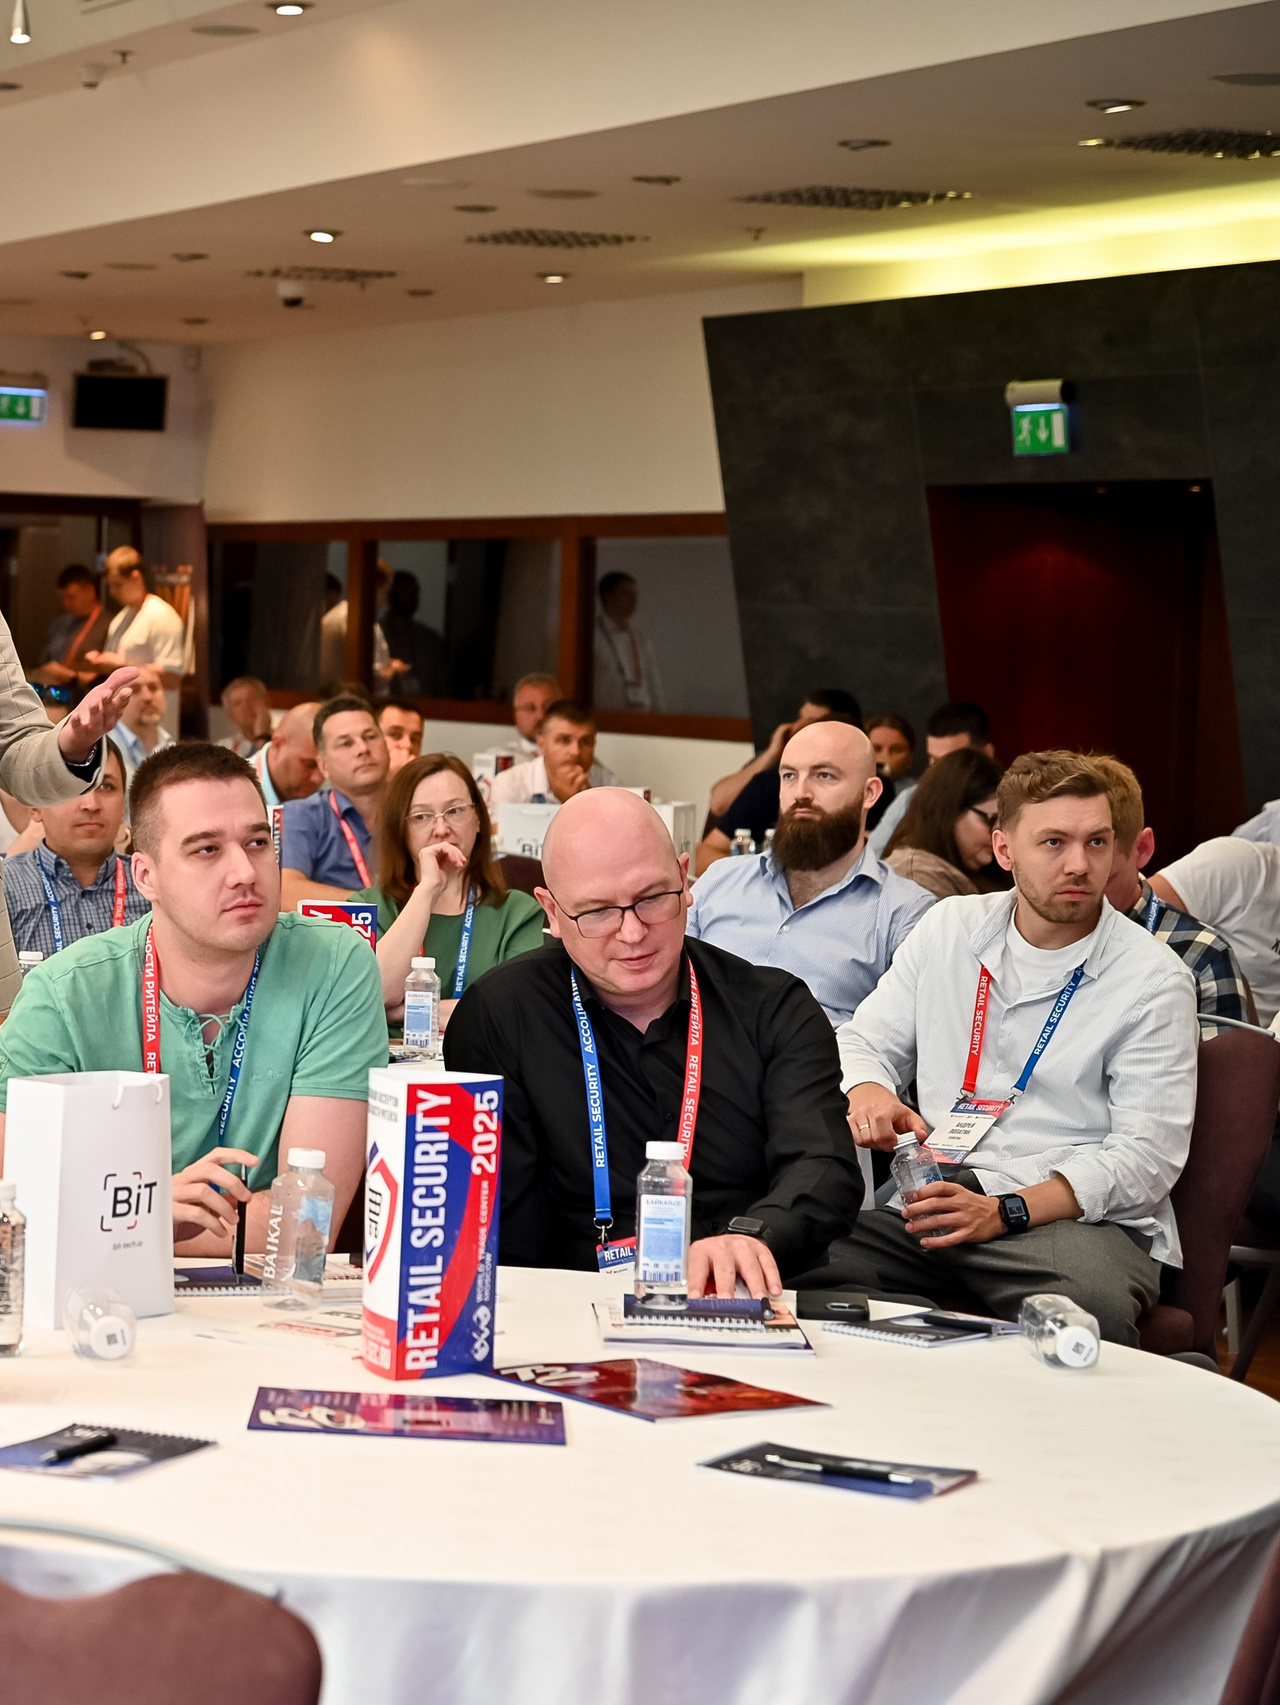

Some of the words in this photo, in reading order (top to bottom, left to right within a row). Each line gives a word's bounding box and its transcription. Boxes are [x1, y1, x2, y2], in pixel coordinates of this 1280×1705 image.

[273, 811, 281, 864] CURITY
[50, 905, 63, 940] SECURITY
[459, 931, 470, 963] SECURITY
[455, 964, 465, 992] RETAIL
[977, 975, 988, 1008] RETAIL
[144, 981, 159, 1043] РИТЕЙЛА
[691, 991, 701, 1046] РИТЕЙЛА
[970, 1008, 984, 1056] SECURITY
[1033, 1023, 1055, 1056] RETAIL
[1049, 980, 1076, 1024] SECURITY
[586, 1063, 604, 1124] SECURITY
[686, 1054, 699, 1097] RETAIL
[679, 1097, 696, 1158] SECURITY
[975, 1104, 1001, 1112] SECURITY
[471, 1089, 500, 1177] 2025
[595, 1124, 606, 1168] RETAIL
[410, 1089, 452, 1249] SECURITY
[111, 1181, 158, 1218] BiT
[479, 1180, 490, 1224] CENTER
[263, 1205, 284, 1280] BAIKAL
[477, 1226, 488, 1262] TRADE
[604, 1246, 633, 1262] RETAIL
[476, 1263, 487, 1303] WORLD
[483, 1252, 493, 1302] MOSCOW
[405, 1254, 443, 1372] RETAIL
